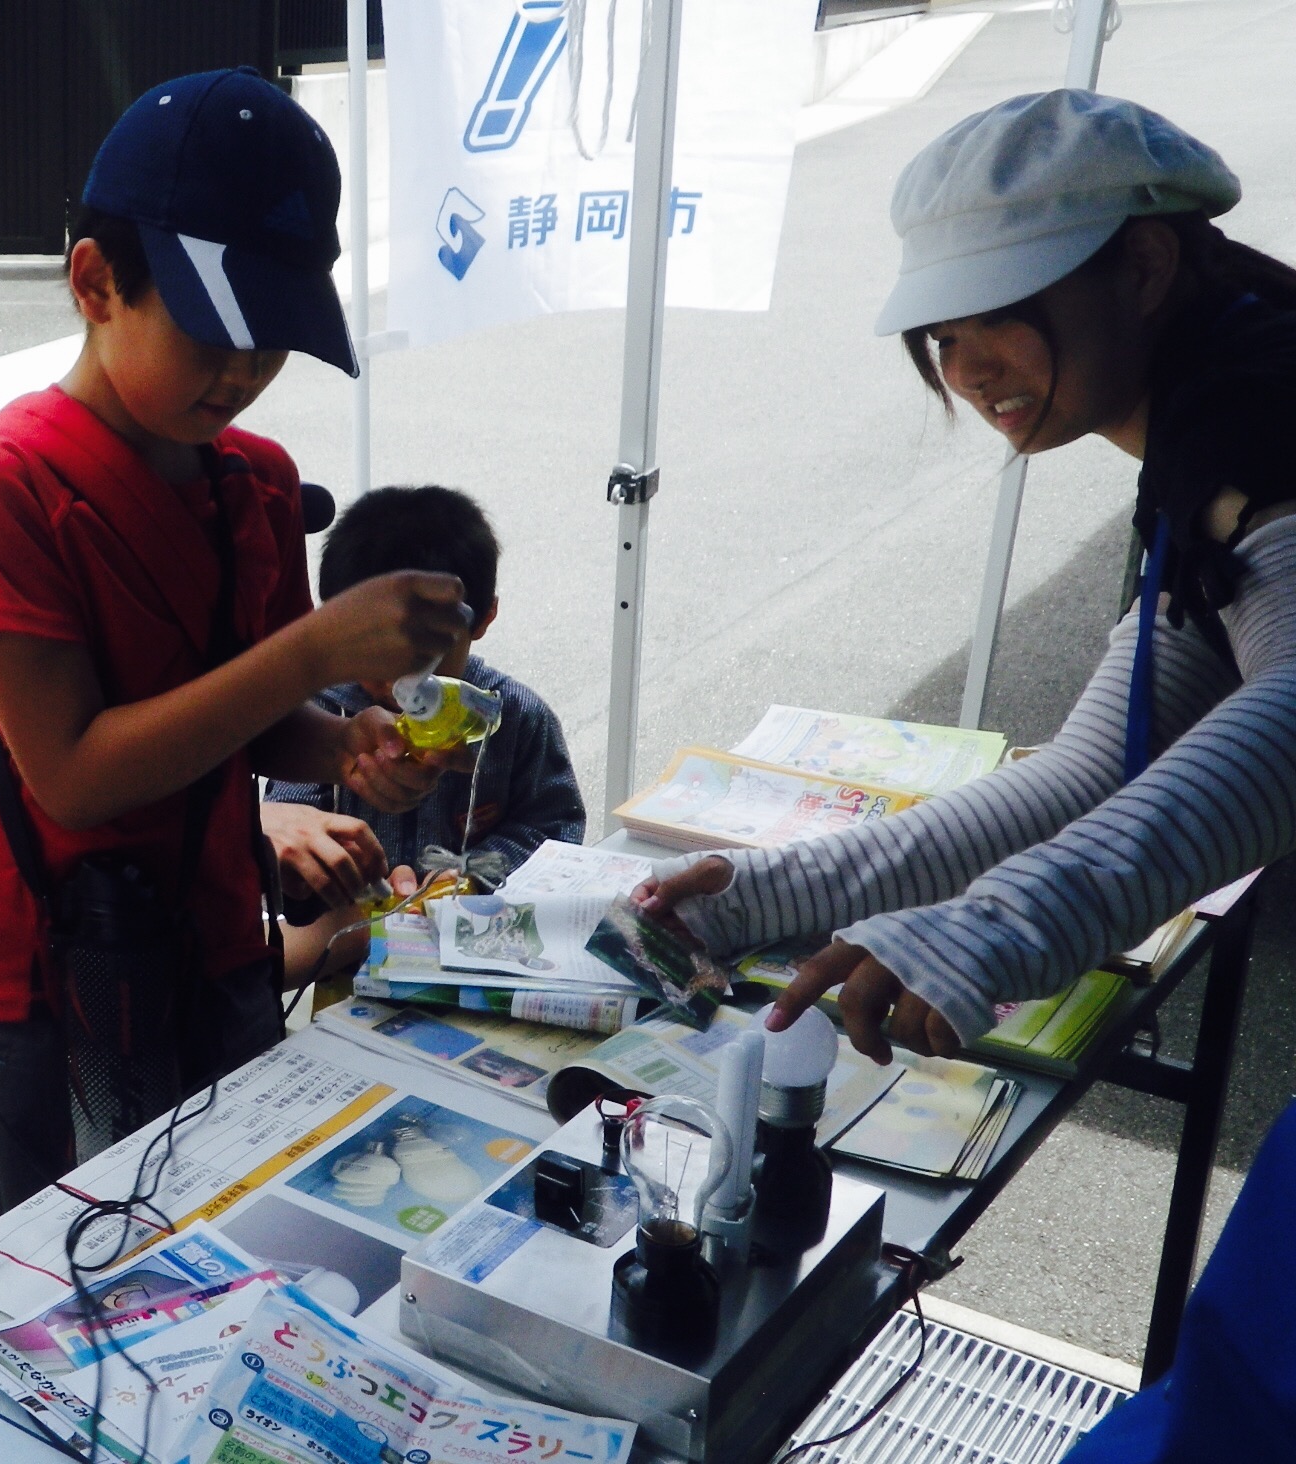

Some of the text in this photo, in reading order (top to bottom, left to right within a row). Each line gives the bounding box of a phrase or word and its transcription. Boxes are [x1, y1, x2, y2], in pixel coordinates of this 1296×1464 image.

[507, 186, 703, 250] 静岡市
[176, 1381, 210, 1406] スタ
[273, 1321, 594, 1460] どうぶつエコクイズラリー
[245, 1409, 283, 1432] ライオン
